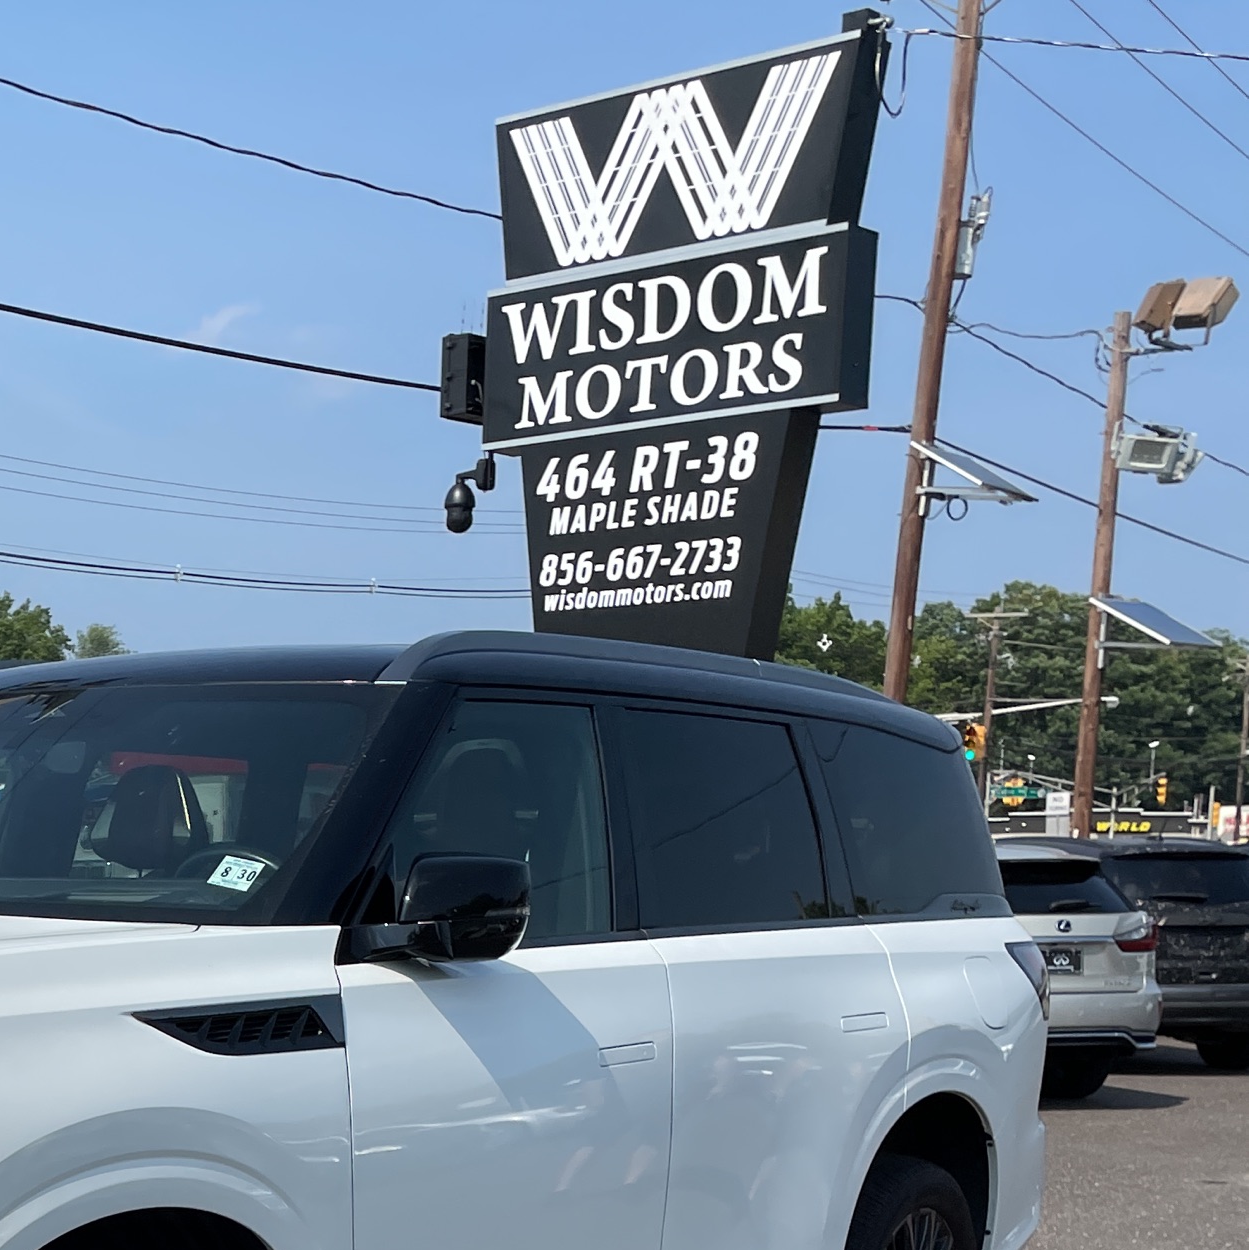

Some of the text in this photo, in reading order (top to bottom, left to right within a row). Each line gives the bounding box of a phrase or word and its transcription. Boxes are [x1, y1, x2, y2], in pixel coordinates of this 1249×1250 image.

[501, 246, 829, 365] WISDOM
[514, 333, 803, 430] MOTORS
[536, 431, 759, 502] 464 RT-38
[549, 487, 739, 536] MAPLE SHADE
[539, 536, 742, 587] 856-667-2733
[544, 579, 733, 612] wisdommotors.com
[221, 867, 257, 881] 8 30
